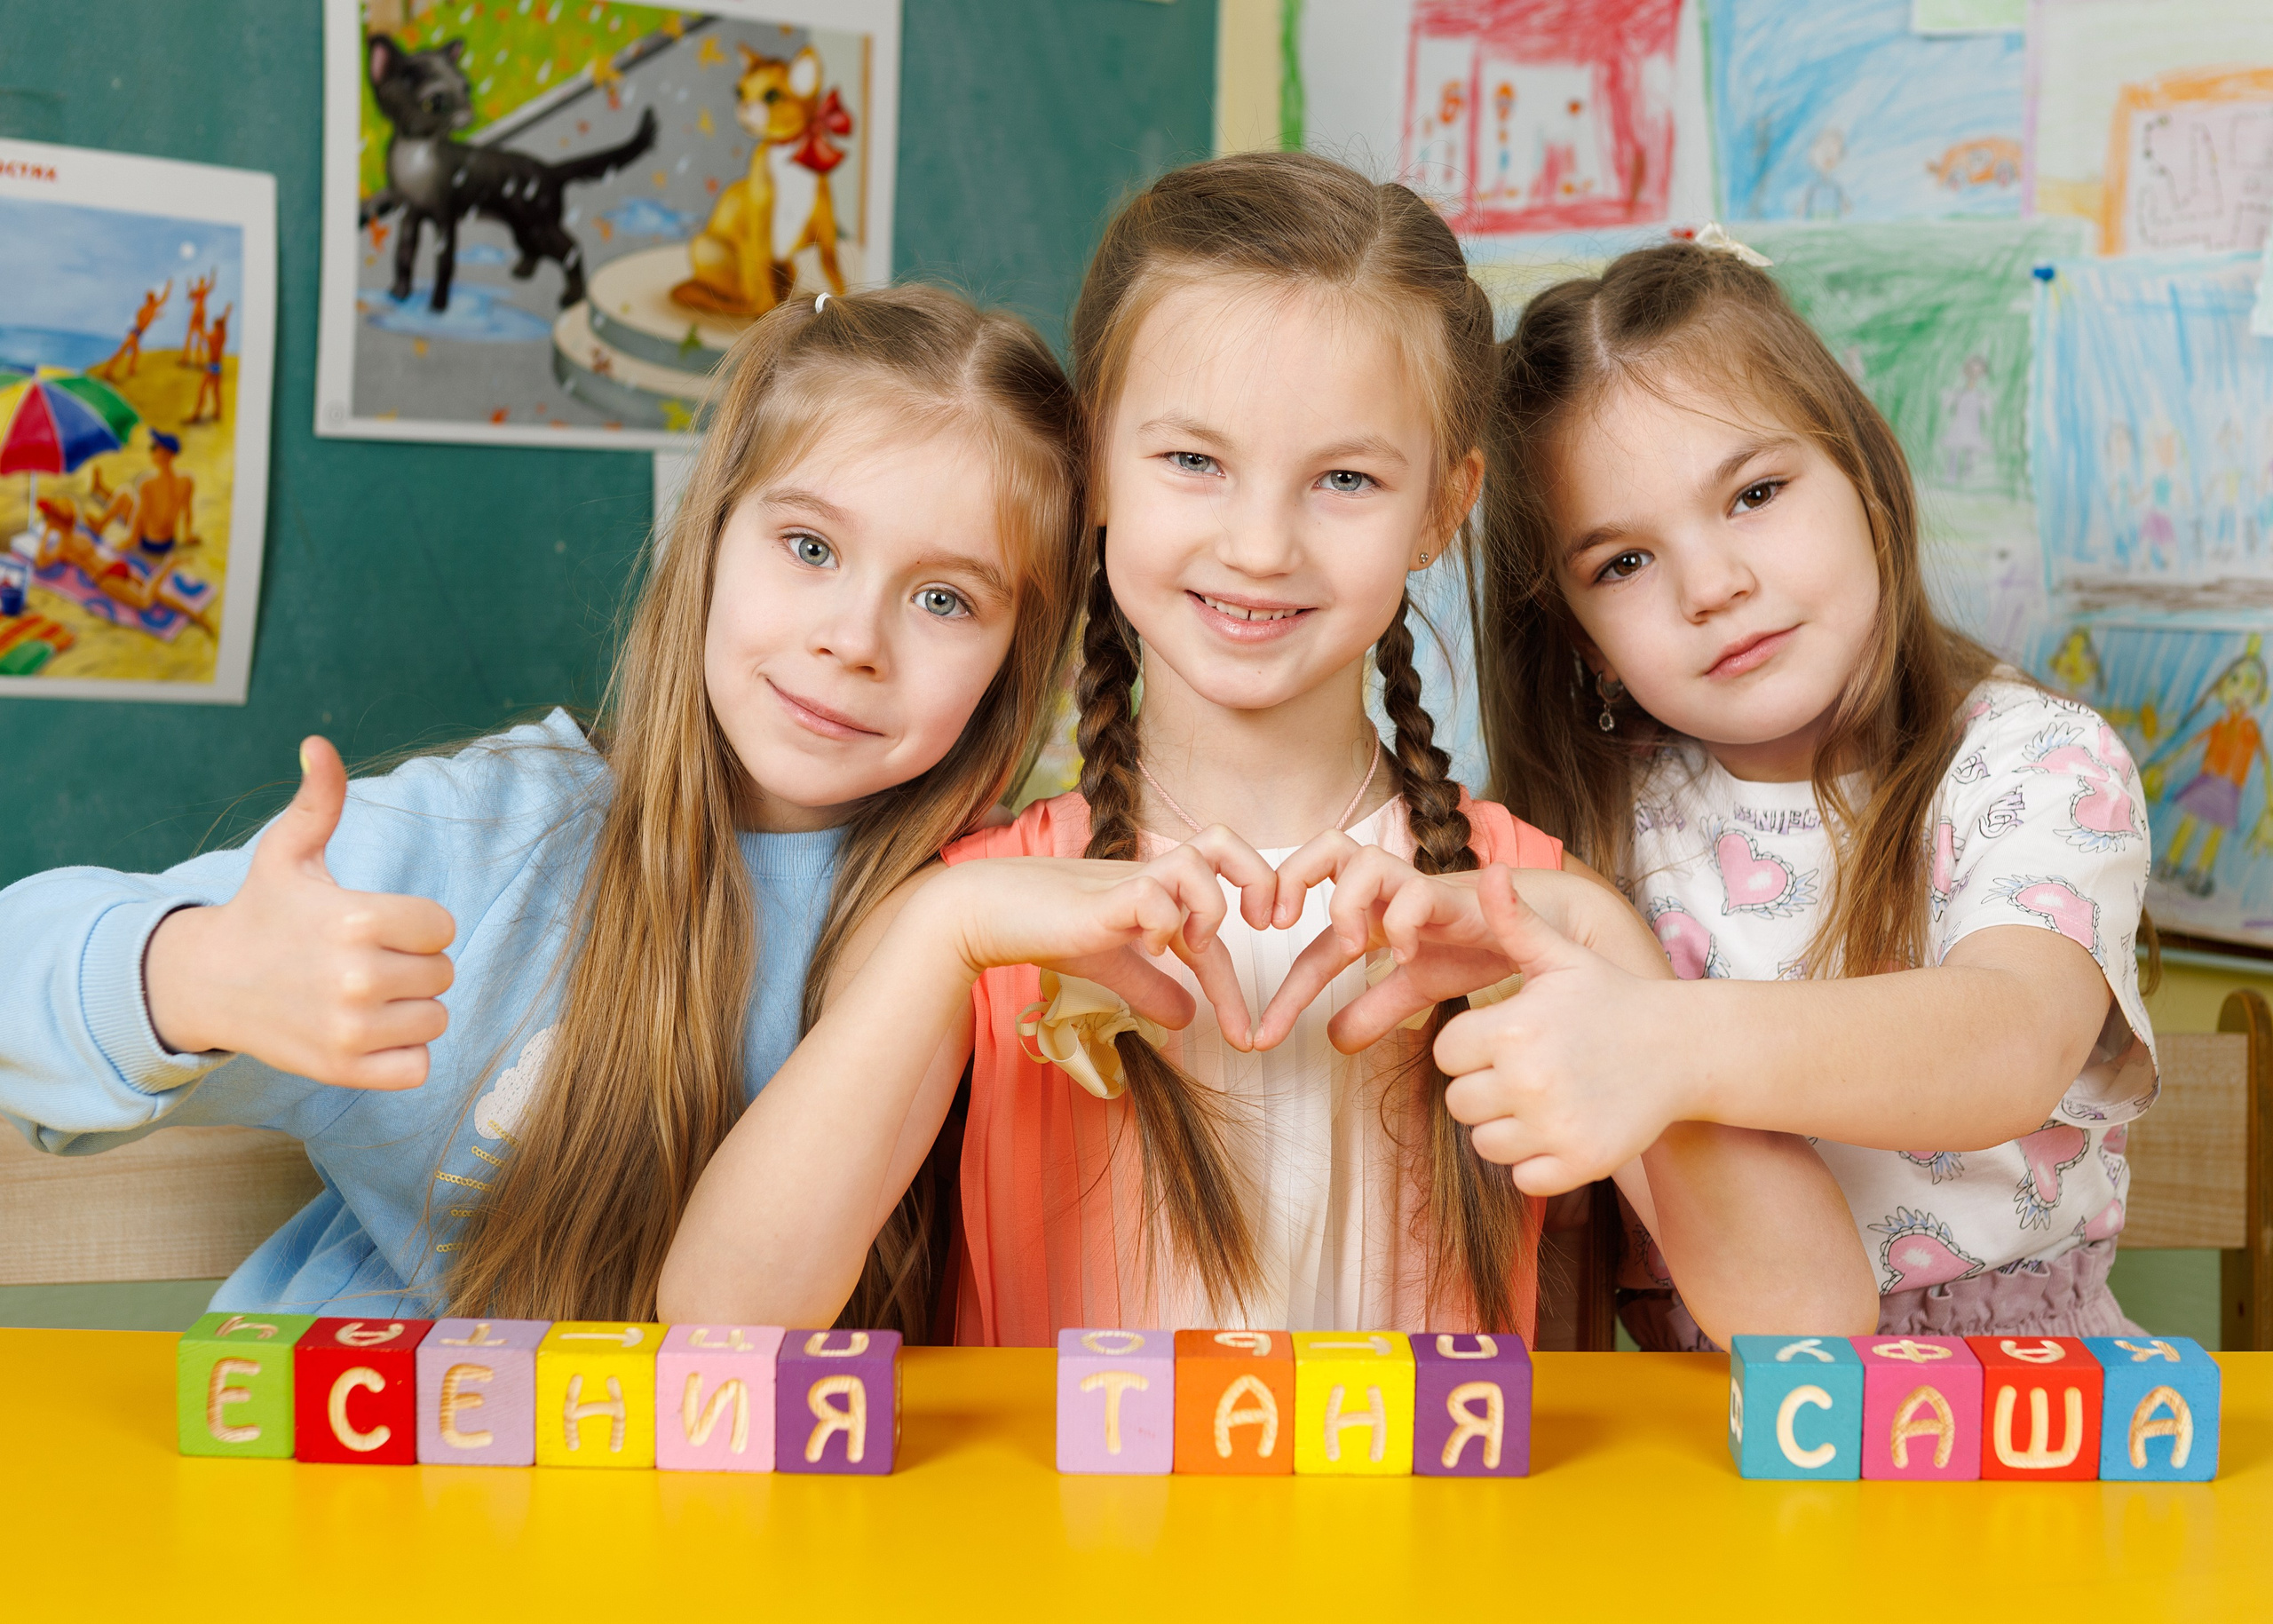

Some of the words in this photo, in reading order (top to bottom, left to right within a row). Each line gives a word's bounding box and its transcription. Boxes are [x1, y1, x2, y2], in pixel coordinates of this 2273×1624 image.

[207, 1357, 867, 1464] ЕСЕНИЯ
[1080, 1370, 1505, 1470] ТАНЯ
[1777, 1383, 2195, 1470] САША
